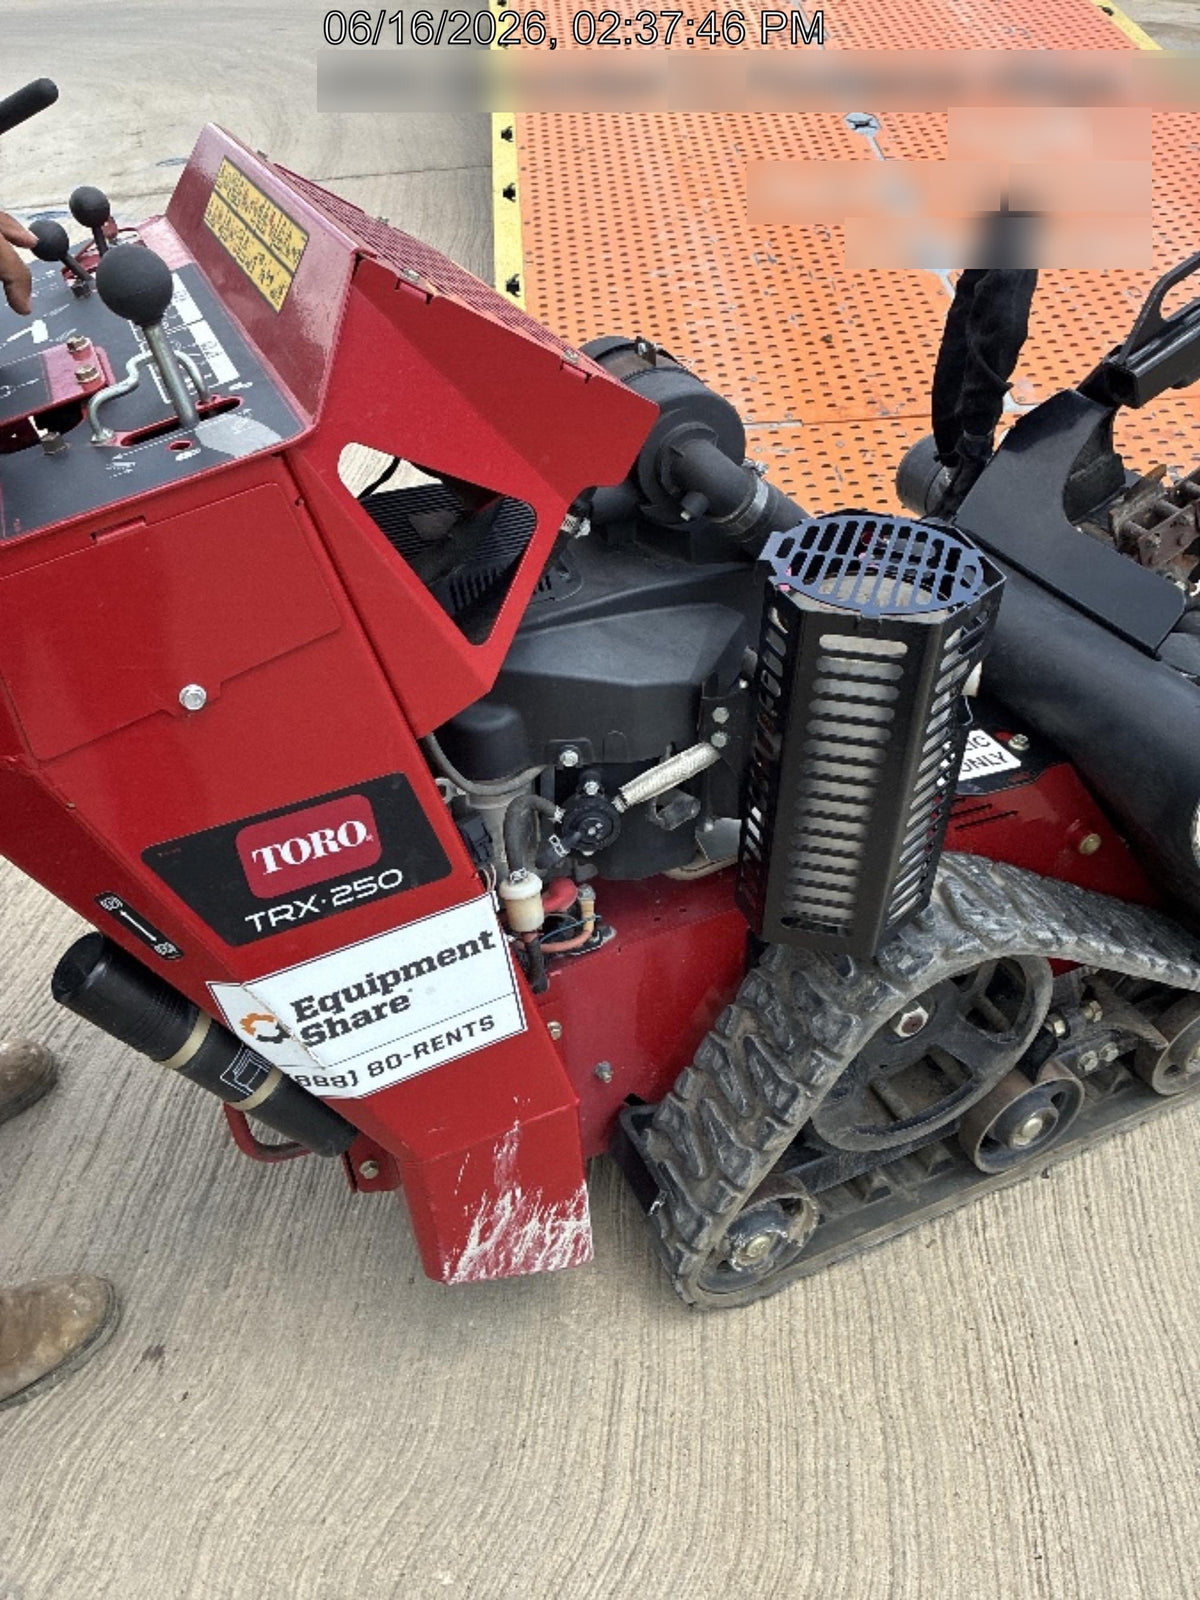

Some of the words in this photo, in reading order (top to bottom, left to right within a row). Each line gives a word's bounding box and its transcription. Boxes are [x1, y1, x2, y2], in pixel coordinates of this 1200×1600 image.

[251, 820, 368, 876] TORO
[289, 929, 497, 1024] Equipment
[287, 1069, 359, 1089] 888)
[367, 1014, 495, 1078] 80-RENTS
[300, 994, 412, 1048] Share
